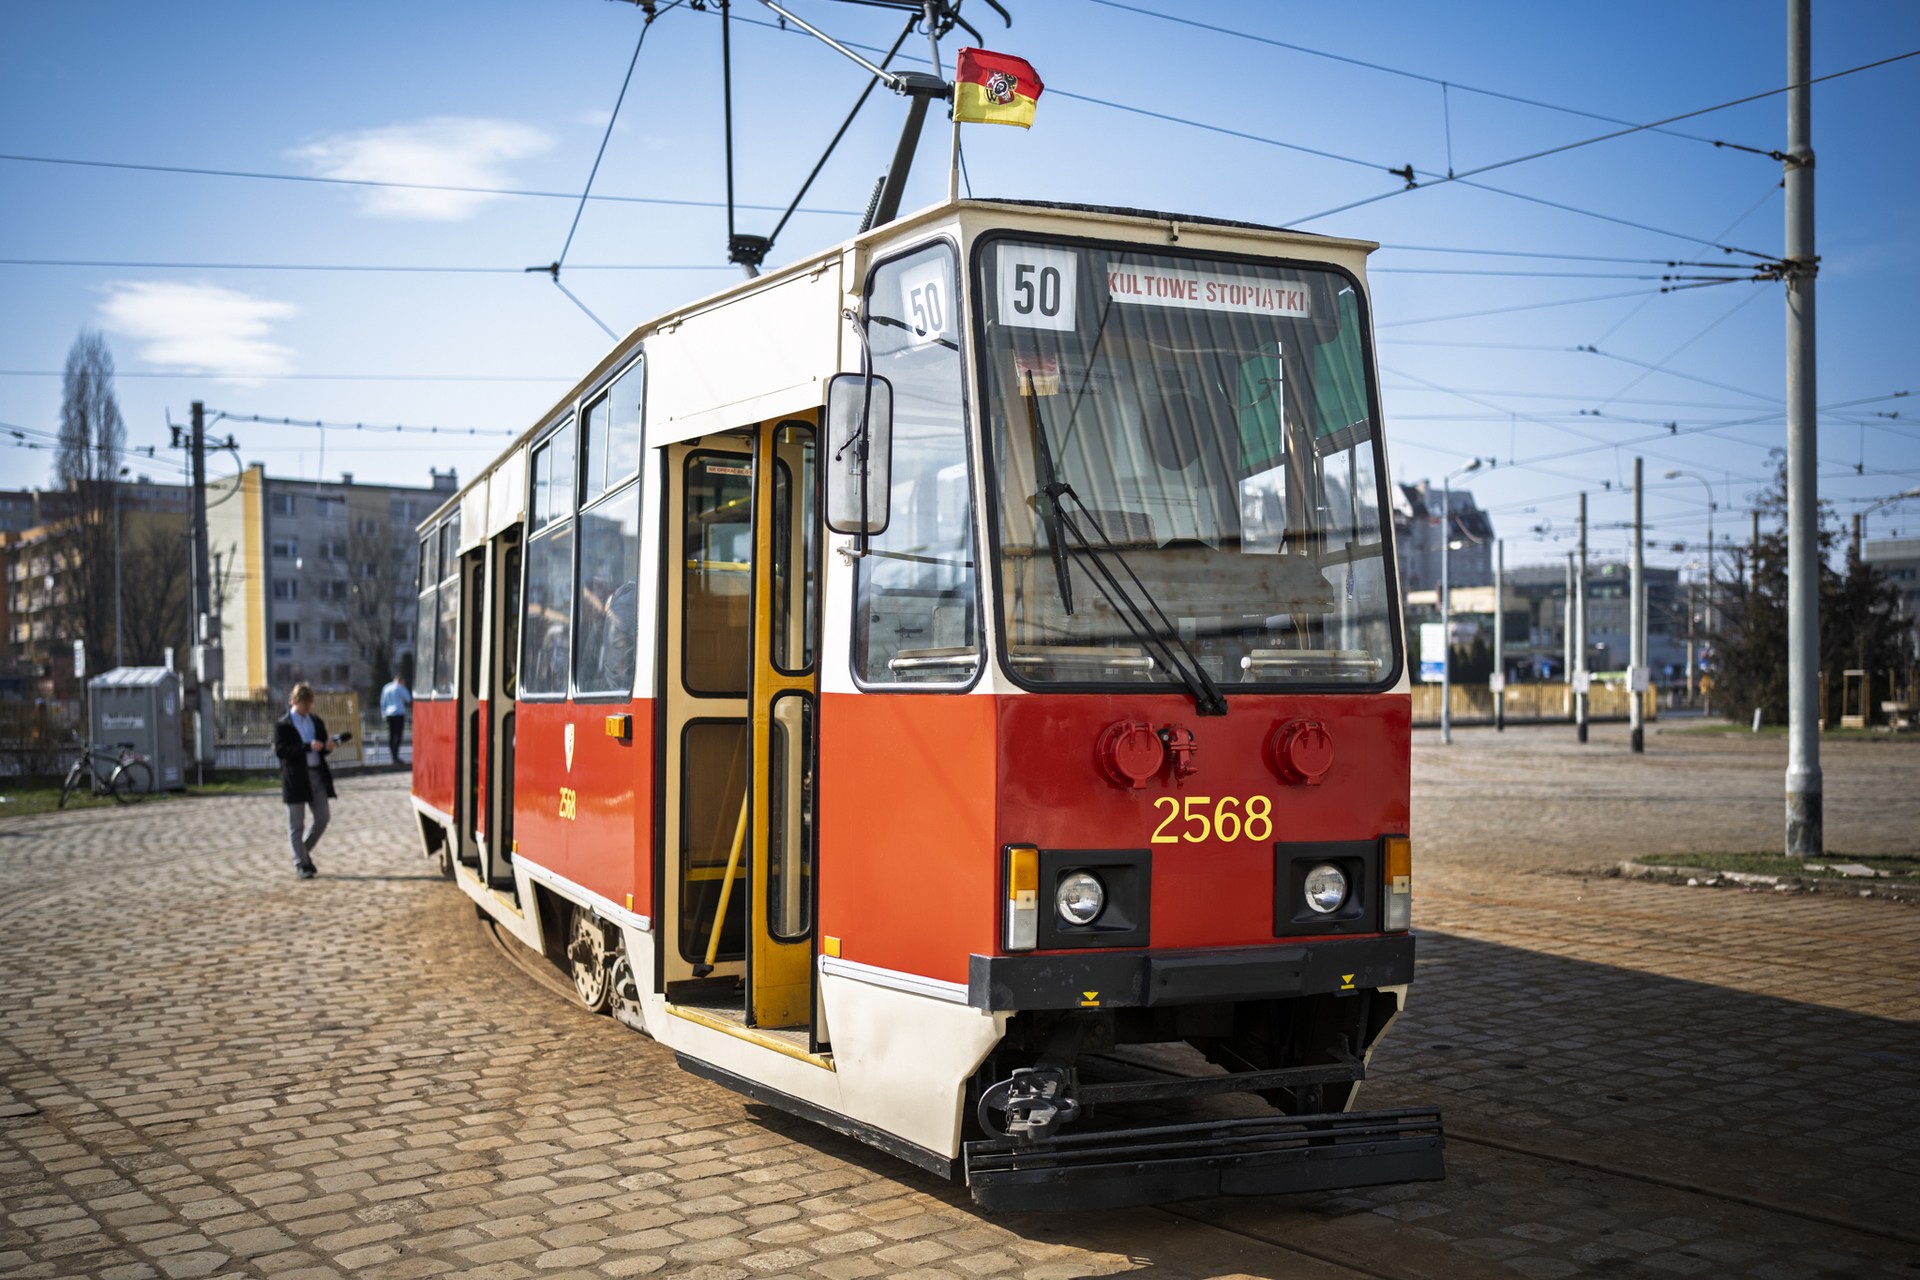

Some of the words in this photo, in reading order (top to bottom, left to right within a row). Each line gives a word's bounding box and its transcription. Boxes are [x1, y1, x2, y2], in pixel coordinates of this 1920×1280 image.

[910, 282, 943, 337] 50
[1014, 264, 1061, 317] 50
[1107, 271, 1198, 300] KULTOWE
[1206, 281, 1304, 312] STOPIĄTKI
[559, 786, 576, 821] 2568
[1150, 795, 1273, 844] 2568
